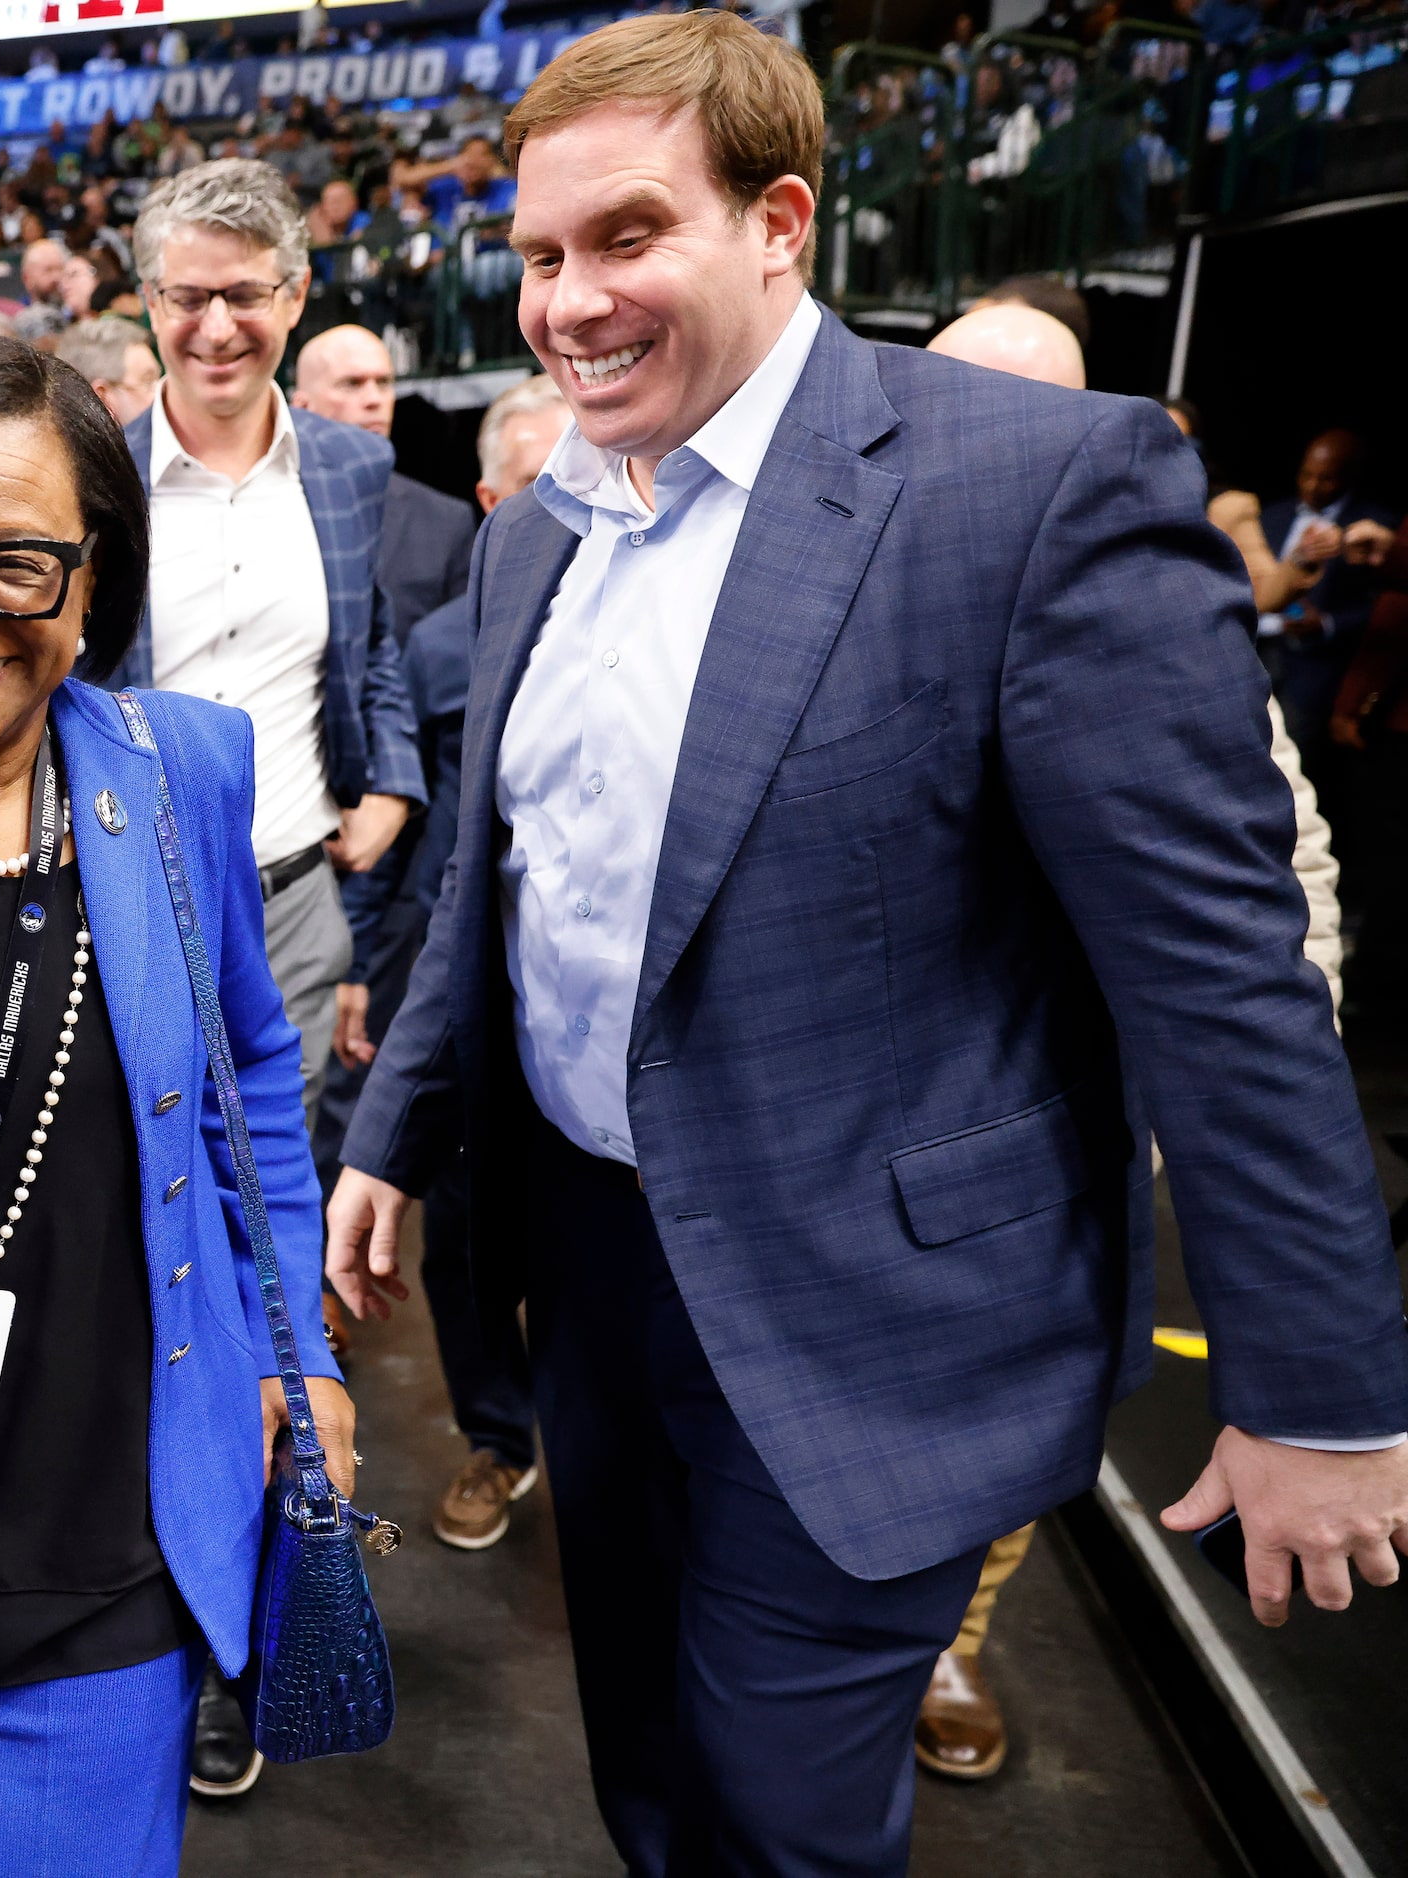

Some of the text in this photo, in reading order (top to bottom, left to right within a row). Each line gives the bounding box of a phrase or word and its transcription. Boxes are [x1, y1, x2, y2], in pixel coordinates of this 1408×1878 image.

[259, 48, 448, 106] PROUD
[36, 764, 58, 875] DALLAS MAVERICKS
[2, 961, 30, 1032] MAVERICKS
